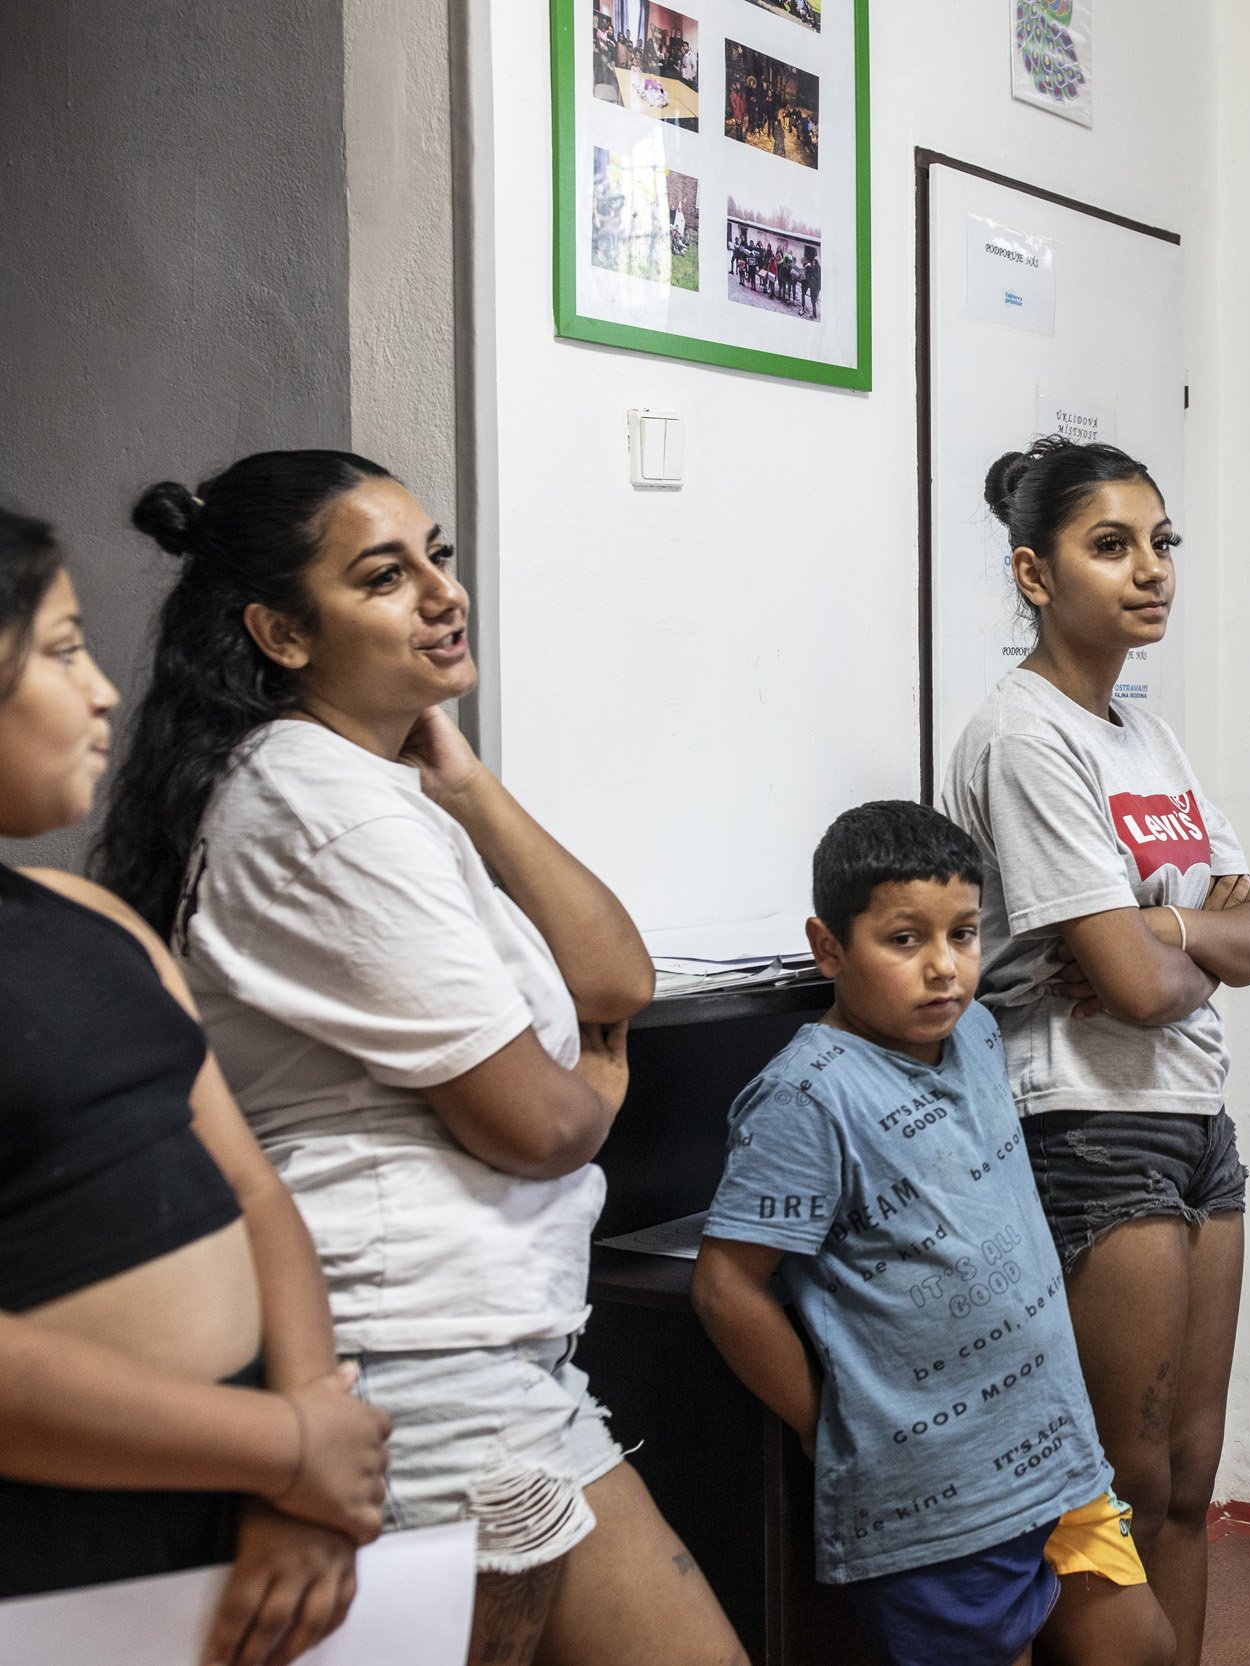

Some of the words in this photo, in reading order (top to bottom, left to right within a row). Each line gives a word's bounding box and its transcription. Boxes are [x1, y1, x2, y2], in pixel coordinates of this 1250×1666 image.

[985, 243, 1023, 262] PODPORUJE
[810, 1044, 845, 1072] kind
[879, 1105, 912, 1133] IT'S
[912, 1088, 947, 1111] ALL
[902, 1107, 947, 1139] GOOD
[970, 1162, 991, 1181] be
[832, 1177, 920, 1242] DREAM
[862, 1261, 887, 1281] be
[898, 1223, 948, 1261] kind
[909, 1256, 977, 1308] IT'S
[981, 1224, 1022, 1265] ALL
[950, 1260, 1020, 1319] GOOD
[914, 1360, 945, 1381] be
[1025, 1297, 1045, 1317] be
[893, 1402, 967, 1444] GOOD
[981, 1353, 1045, 1401] MOOD
[993, 1438, 1033, 1471] IT'S
[1038, 1415, 1067, 1444] ALL
[1013, 1436, 1062, 1477] GOOD
[854, 1519, 885, 1539] be
[895, 1483, 957, 1520] kind
